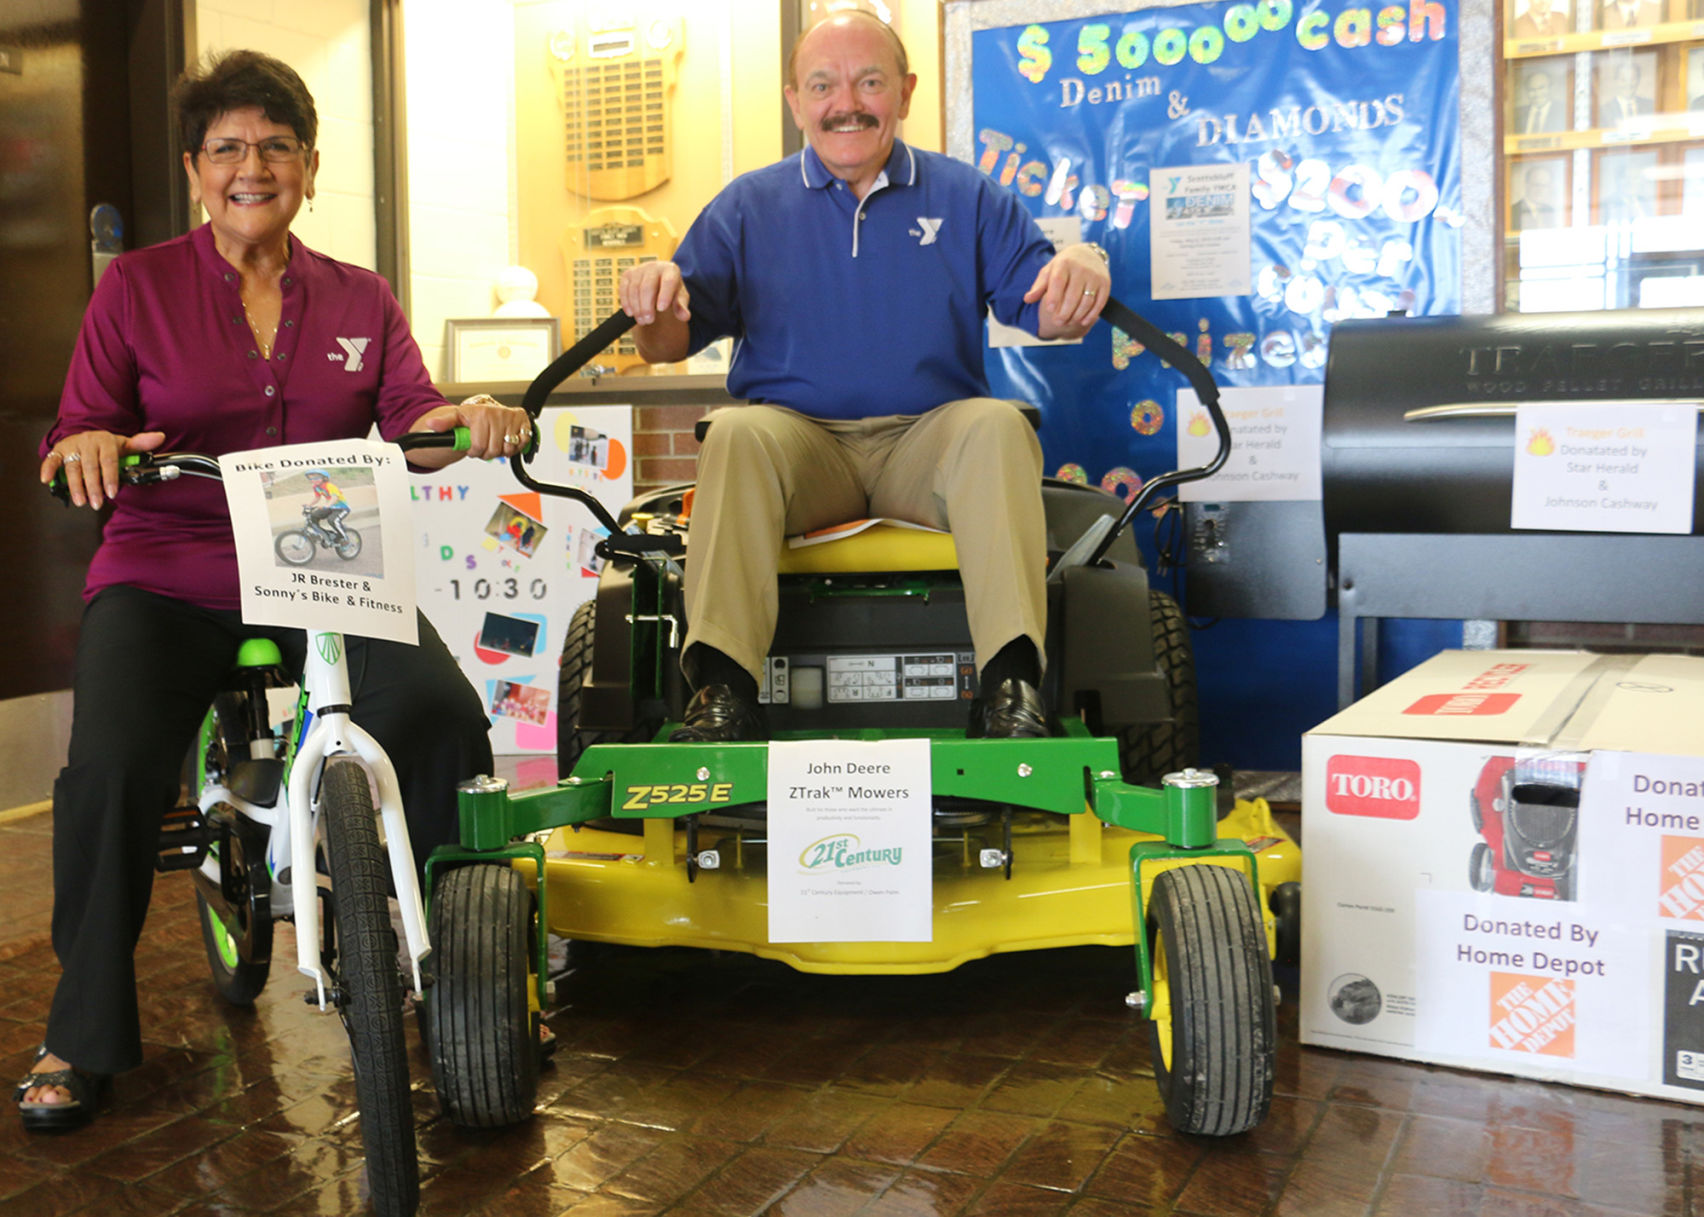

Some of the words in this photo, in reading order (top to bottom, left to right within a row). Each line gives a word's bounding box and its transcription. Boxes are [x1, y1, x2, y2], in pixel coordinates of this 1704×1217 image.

[1017, 24, 1052, 83] $
[1296, 0, 1447, 51] cash
[1059, 74, 1161, 108] Denim
[1167, 90, 1190, 120] &
[1196, 94, 1406, 147] DIAMONDS
[327, 352, 344, 361] the
[1275, 424, 1287, 435] by
[1565, 426, 1612, 439] Traeger
[1617, 427, 1645, 439] Grill
[1246, 439, 1281, 449] Herald
[1560, 444, 1628, 457] Donatated
[1632, 446, 1648, 458] by
[235, 463, 273, 472] Bike
[280, 455, 357, 468] Donated
[363, 454, 392, 466] By:
[1248, 455, 1257, 465] &
[1567, 462, 1592, 473] Star
[1596, 463, 1638, 474] Herald
[1252, 471, 1299, 481] Cashway
[1598, 480, 1608, 491] &
[1544, 496, 1597, 508] Johnson
[1601, 498, 1658, 511] Cashway
[291, 573, 306, 583] JR
[311, 575, 358, 589] Brester
[362, 582, 371, 592] &
[254, 586, 308, 601] Sonny's
[313, 592, 340, 604] Bike
[347, 596, 356, 606] &
[360, 597, 403, 613] Fitness
[807, 762, 842, 774] John
[847, 763, 891, 774] Deere
[848, 786, 909, 799] Mowers
[1331, 773, 1414, 802] TORO
[1626, 807, 1700, 831] Home
[1464, 914, 1561, 940] Donated
[1571, 924, 1599, 947] By
[1457, 944, 1524, 968] Home
[1533, 952, 1605, 977] Depot
[1496, 981, 1535, 1012] THE
[1489, 978, 1576, 1051] HOME
[1520, 1007, 1576, 1054] DEPOT
